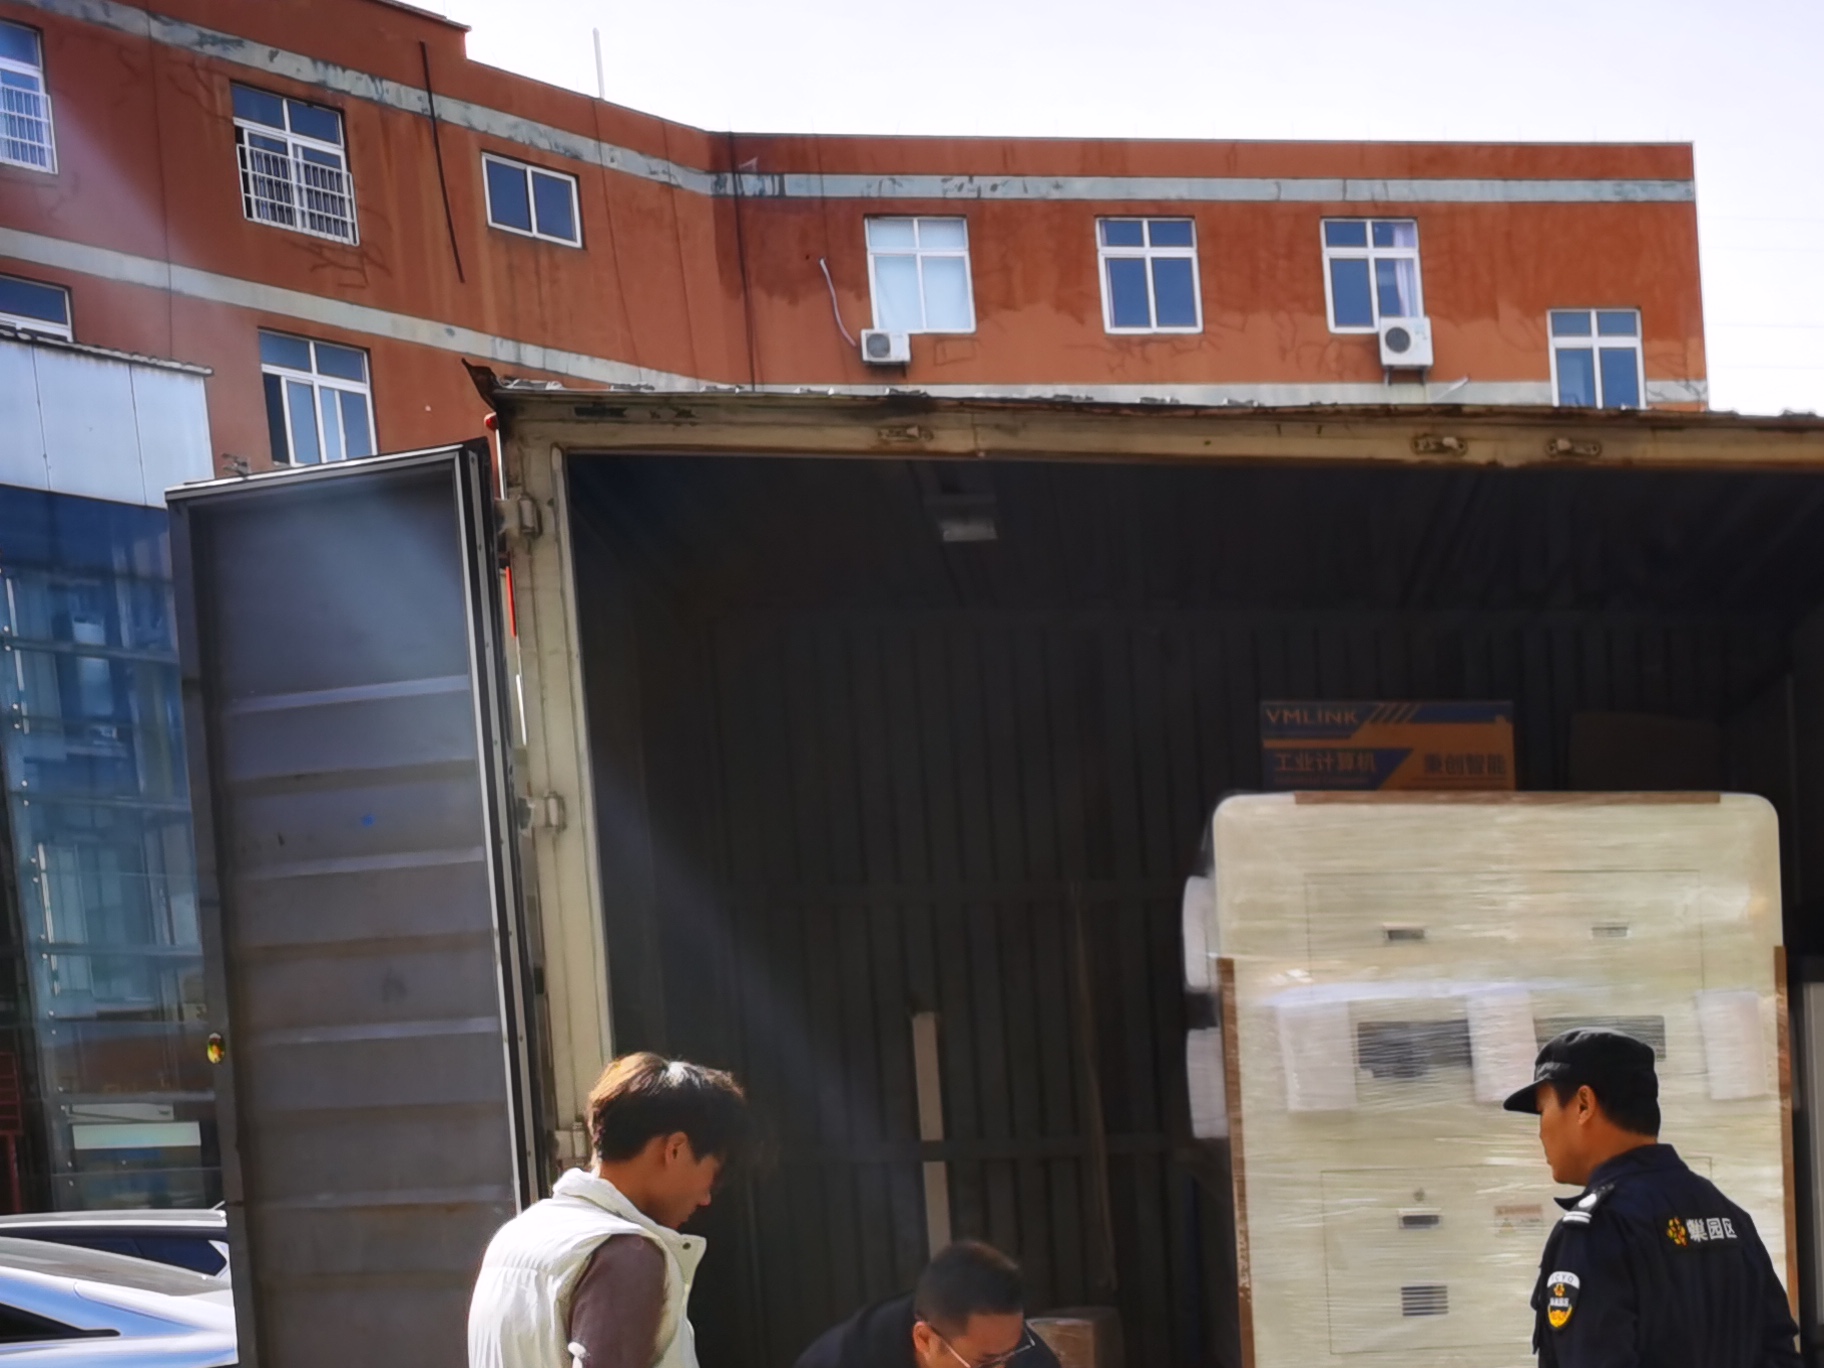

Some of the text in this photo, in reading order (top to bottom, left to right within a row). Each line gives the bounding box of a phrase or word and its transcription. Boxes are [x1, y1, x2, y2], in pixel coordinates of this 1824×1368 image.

[1266, 709, 1358, 725] VMLINK
[1274, 752, 1376, 772] 工业计算机
